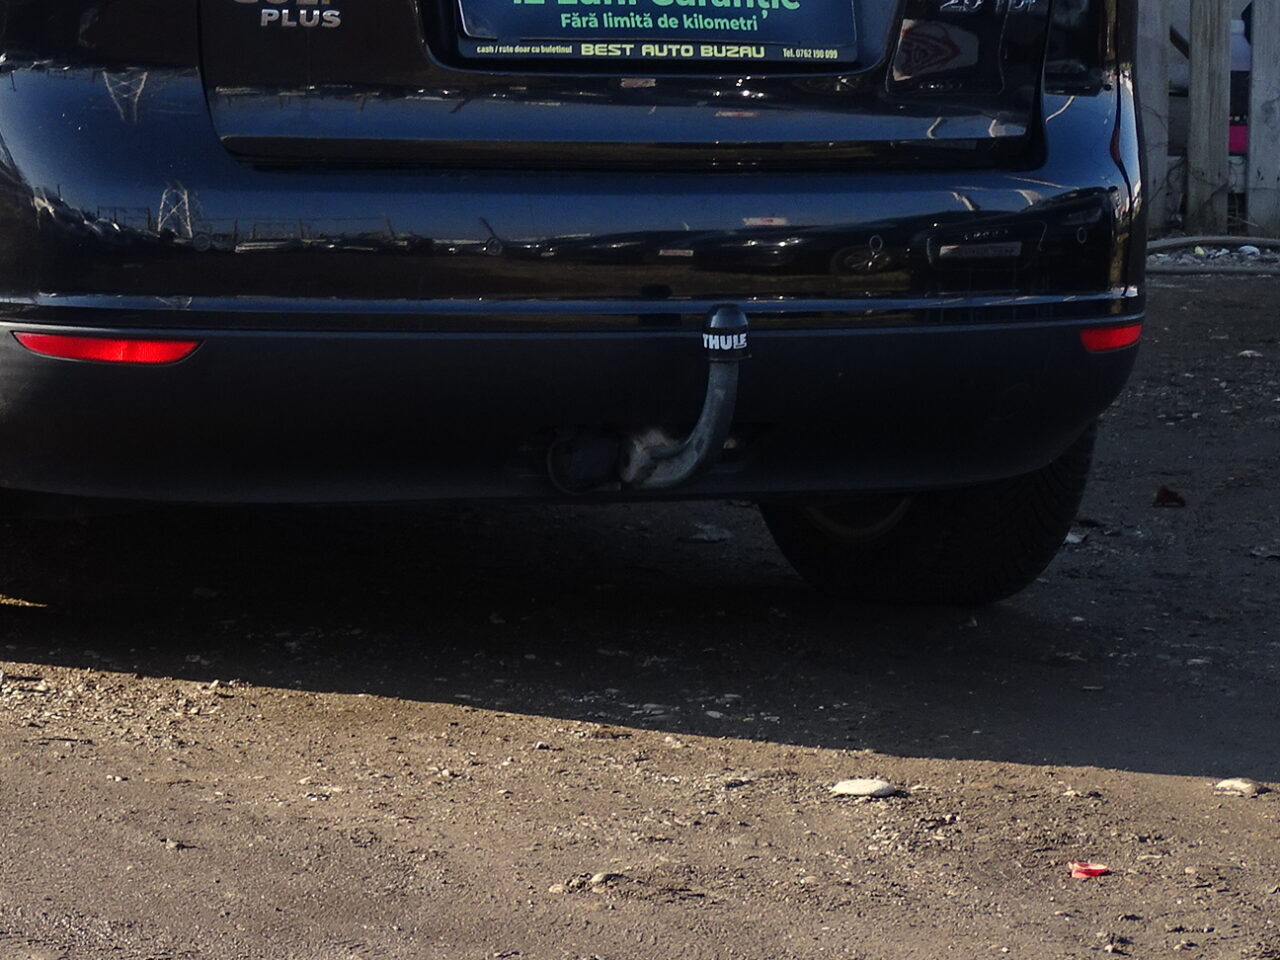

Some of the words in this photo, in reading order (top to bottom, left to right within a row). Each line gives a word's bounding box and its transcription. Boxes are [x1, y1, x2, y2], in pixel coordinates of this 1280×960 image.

[260, 9, 342, 28] PLUS
[560, 13, 599, 28] Fără
[603, 13, 652, 29] limită
[657, 14, 679, 29] de
[683, 14, 758, 31] kilometri
[581, 44, 634, 56] BEST
[642, 45, 694, 57] AUTO
[701, 45, 765, 58] BUZAU
[783, 48, 796, 58] Tel.
[702, 333, 747, 350] THULE
